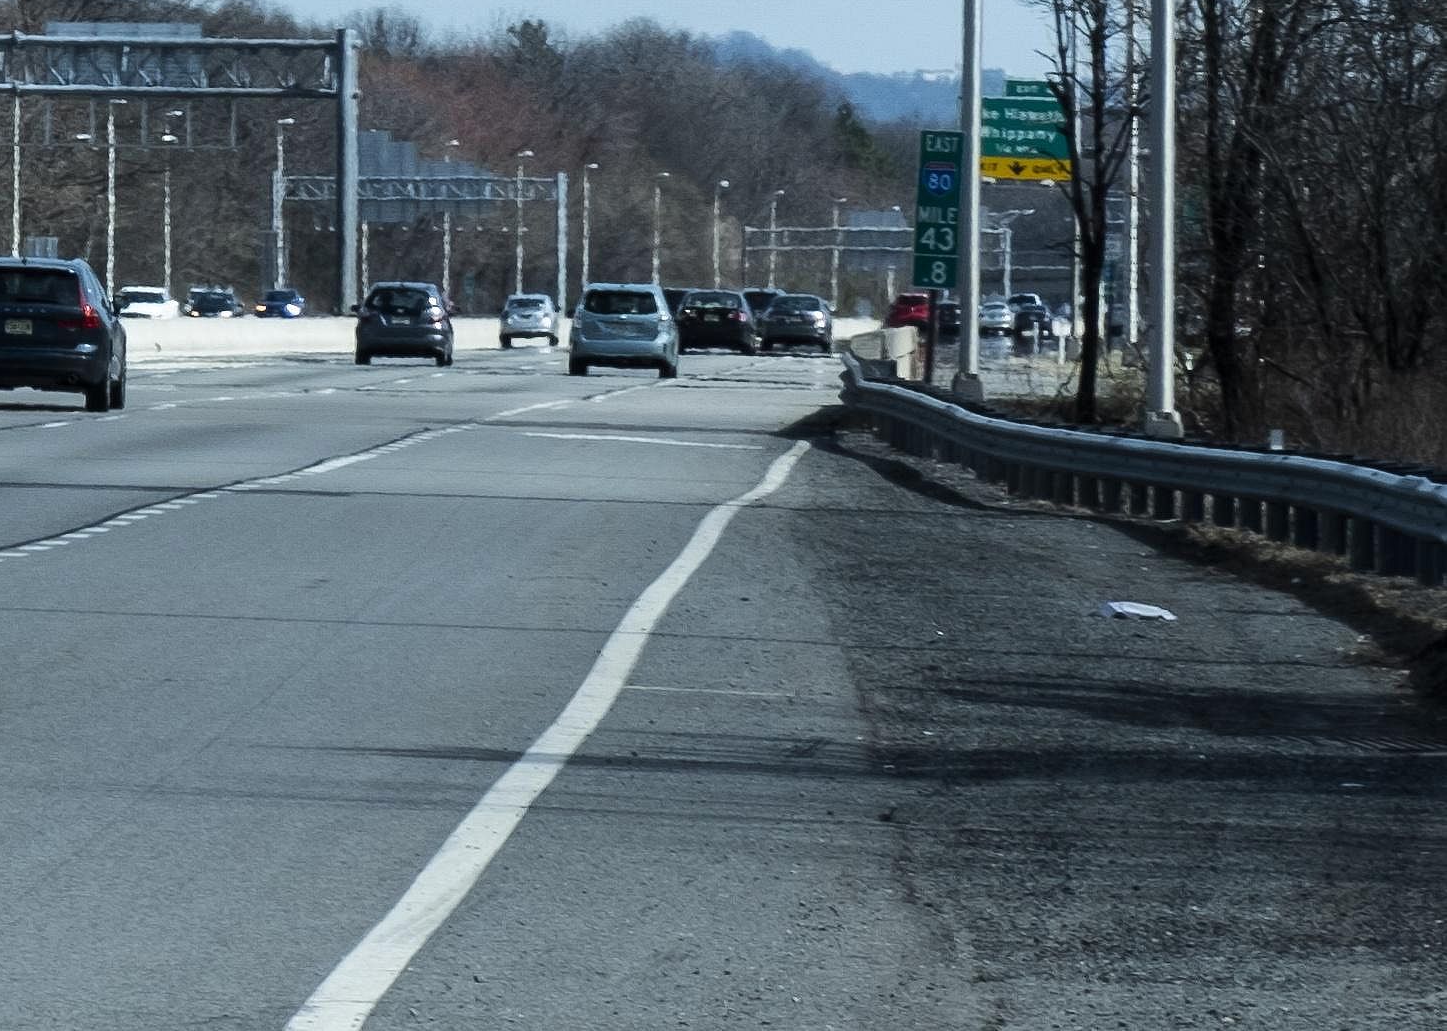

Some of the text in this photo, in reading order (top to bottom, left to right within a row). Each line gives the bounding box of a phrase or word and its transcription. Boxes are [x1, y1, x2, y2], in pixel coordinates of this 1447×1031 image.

[925, 134, 960, 153] EAST
[928, 172, 952, 191] 80
[918, 205, 959, 225] MILE
[919, 226, 955, 252] 43
